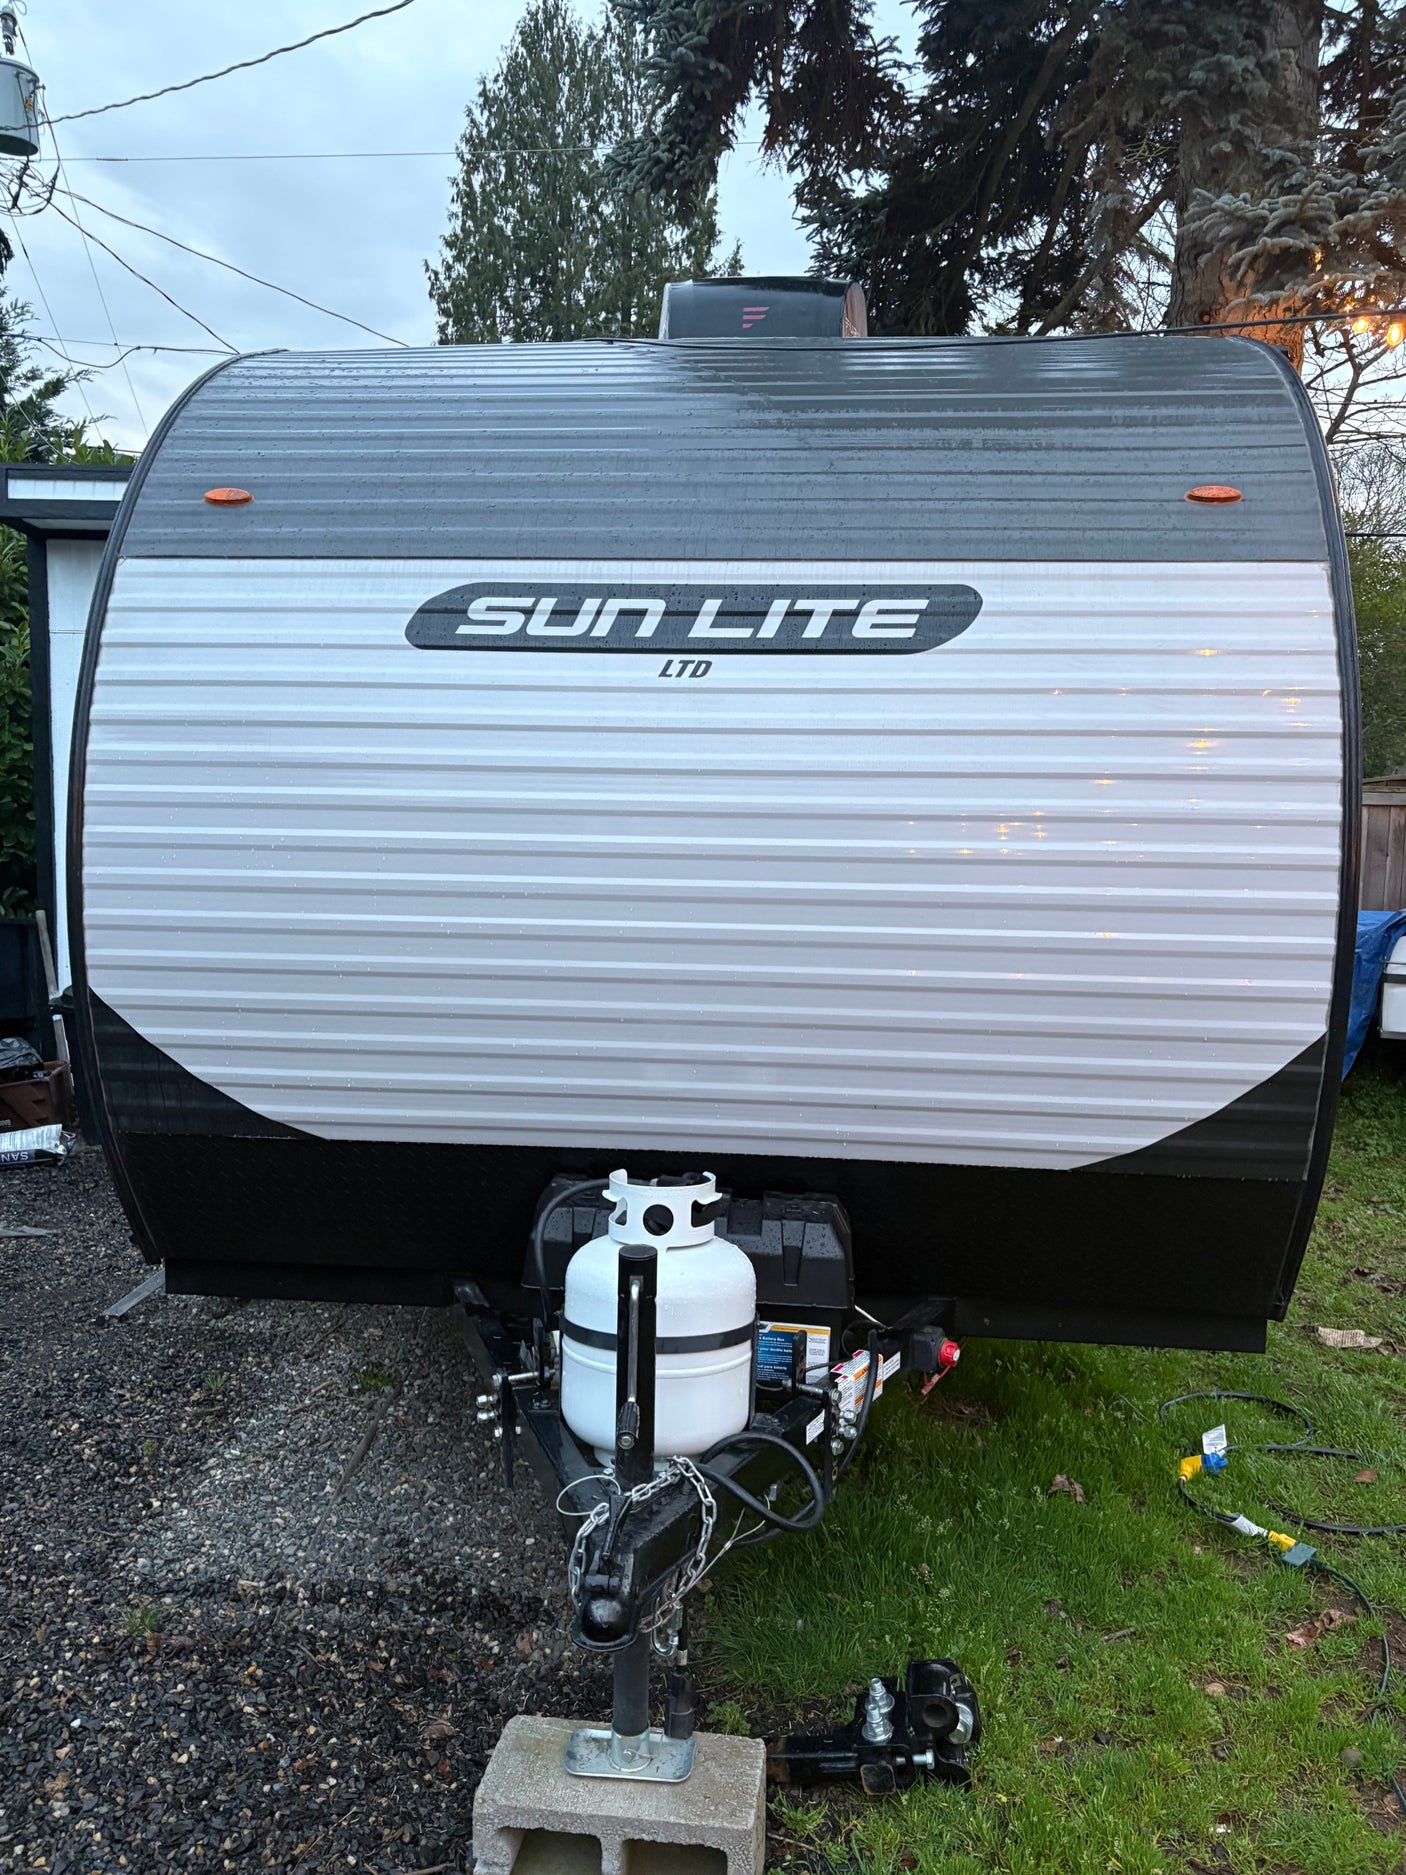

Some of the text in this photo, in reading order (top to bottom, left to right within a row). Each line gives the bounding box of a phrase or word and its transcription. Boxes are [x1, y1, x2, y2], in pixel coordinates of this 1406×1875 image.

[454, 597, 930, 638] SUN LITE
[658, 659, 713, 679] LTD
